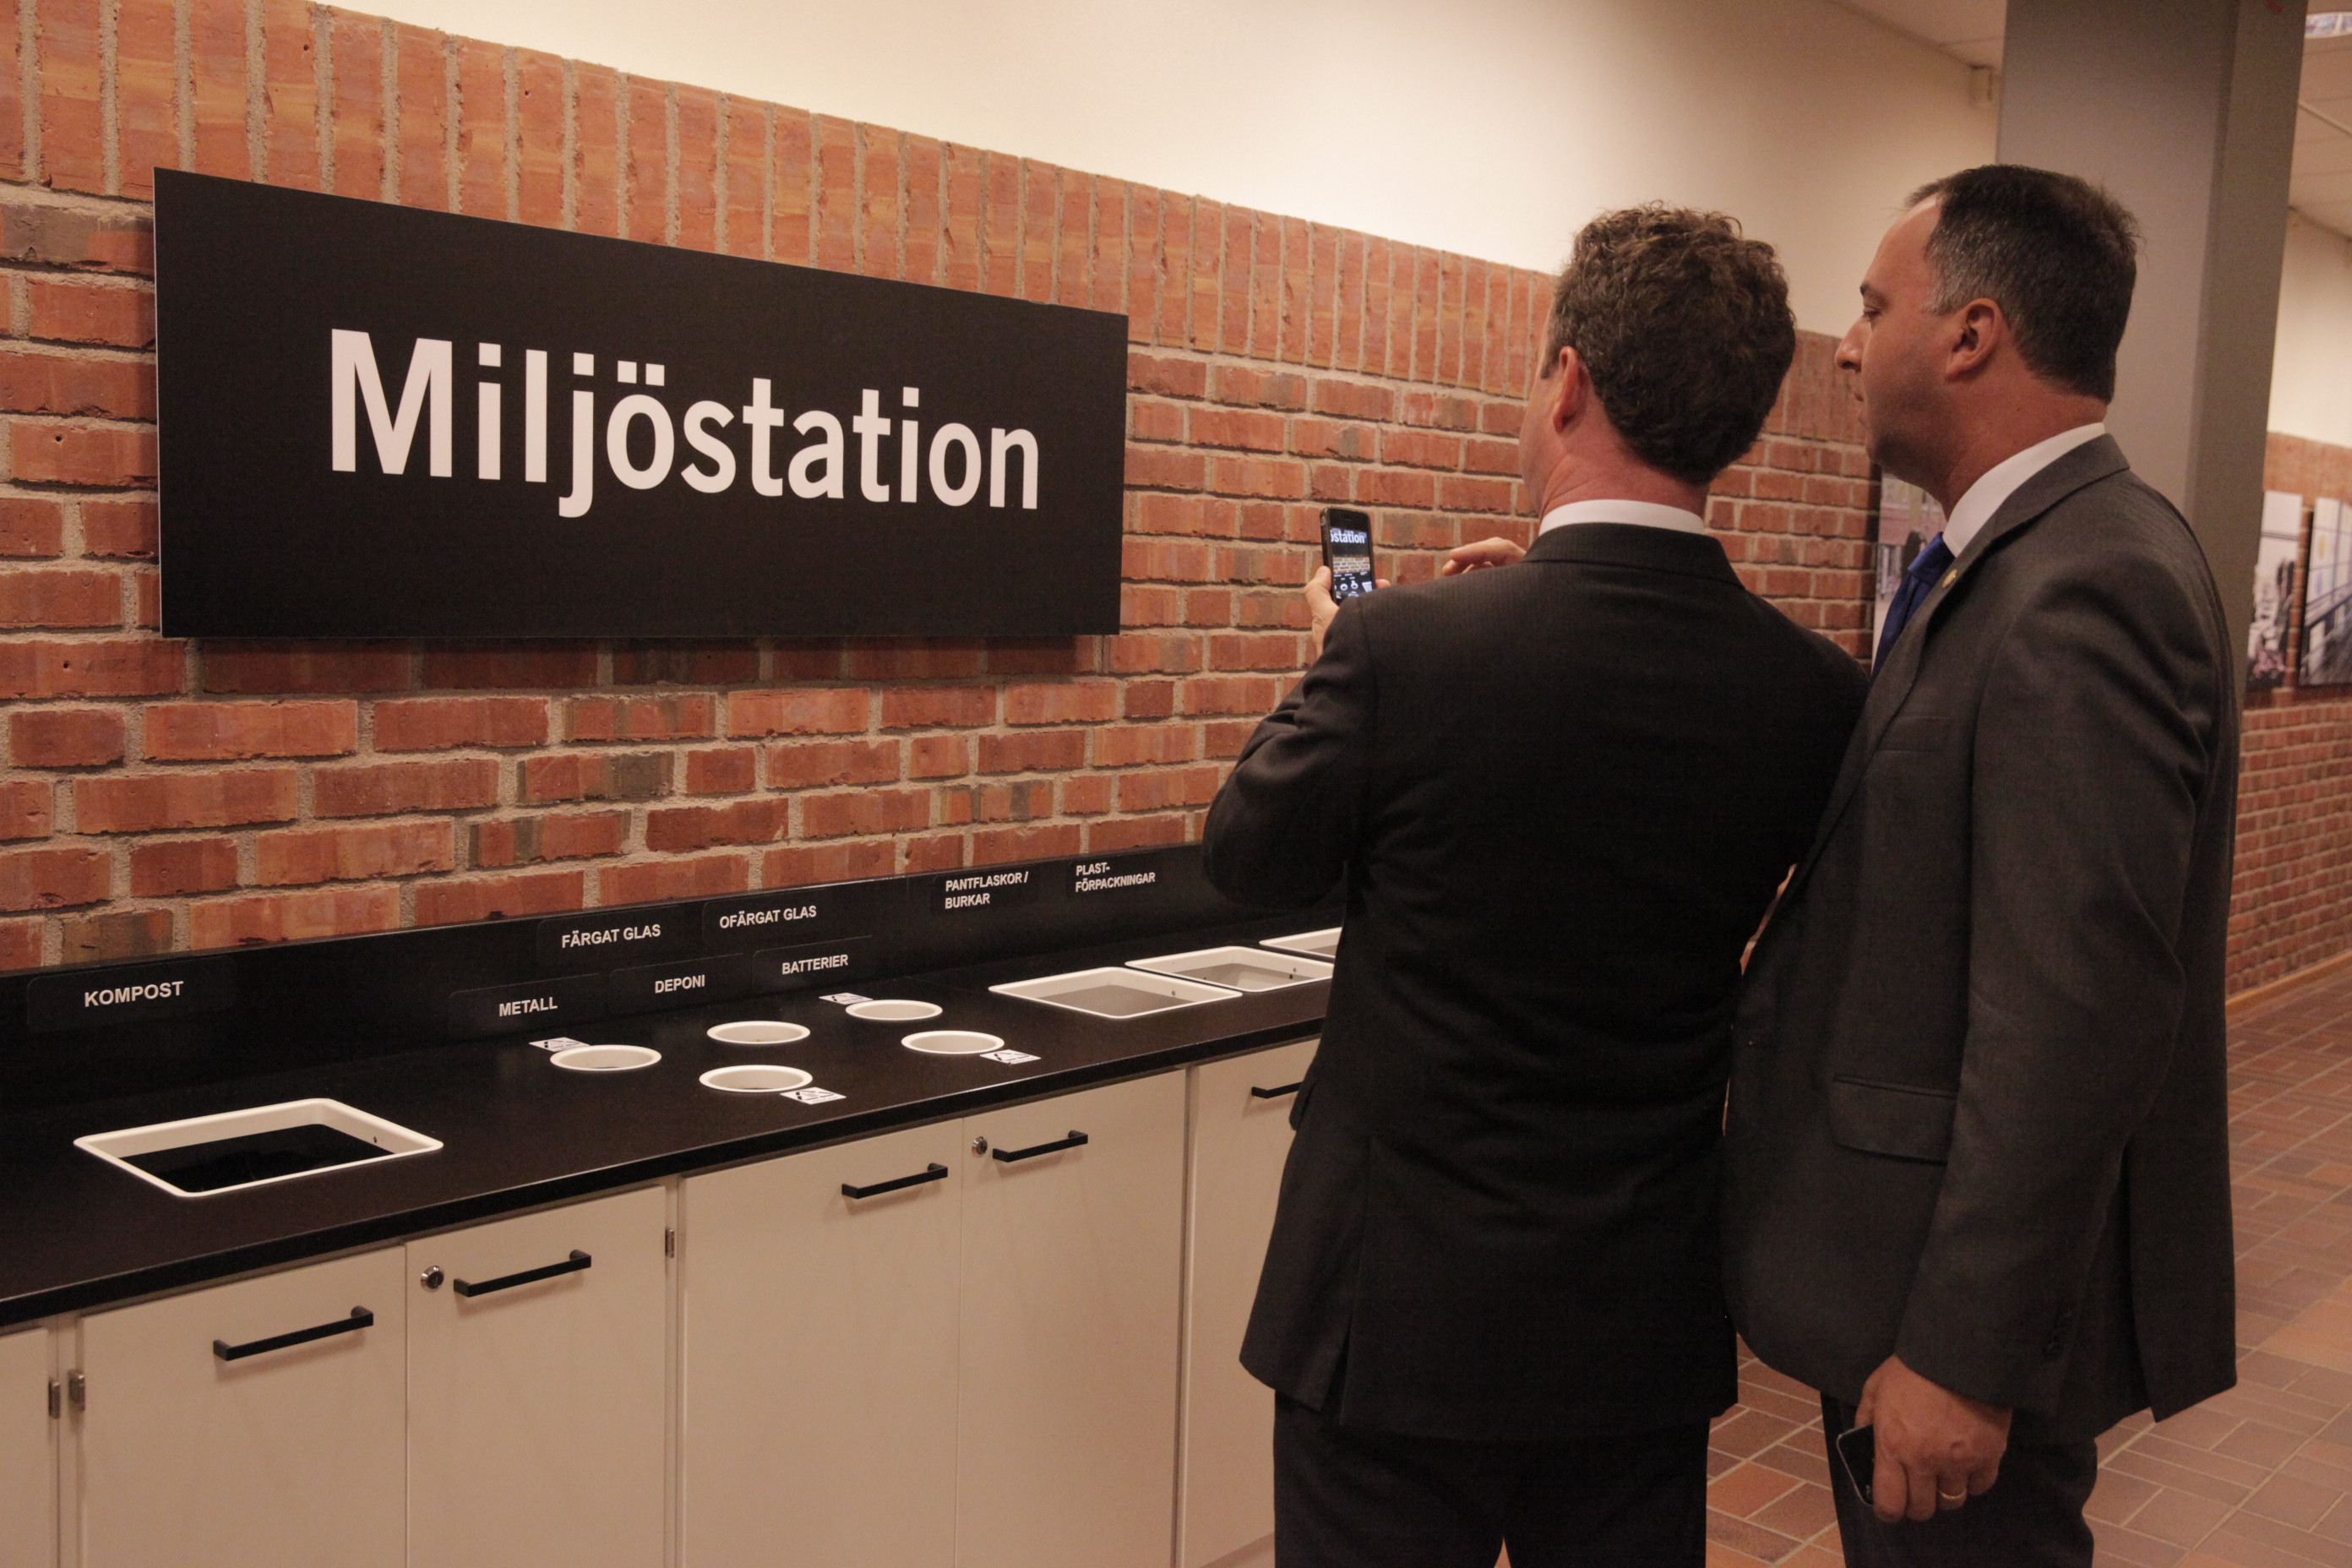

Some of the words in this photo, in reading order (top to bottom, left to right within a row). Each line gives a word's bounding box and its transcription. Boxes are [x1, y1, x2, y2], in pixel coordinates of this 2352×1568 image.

[330, 327, 1040, 519] Miljöstation
[1075, 863, 1110, 877] PLAST-
[945, 872, 1022, 892] PANTFLASKOR
[1075, 872, 1156, 893] FÖRPACKNINGAR
[945, 893, 991, 909] BURKAR
[719, 908, 781, 929] OFÄRGAT
[783, 905, 817, 922] GLAS
[562, 927, 619, 949] FÄRGAT
[622, 923, 662, 942] GLAS
[781, 954, 849, 975] BATTERIER
[84, 980, 184, 1007] KOMPOST
[655, 974, 705, 994] DEPONI
[498, 996, 558, 1017] METALL
